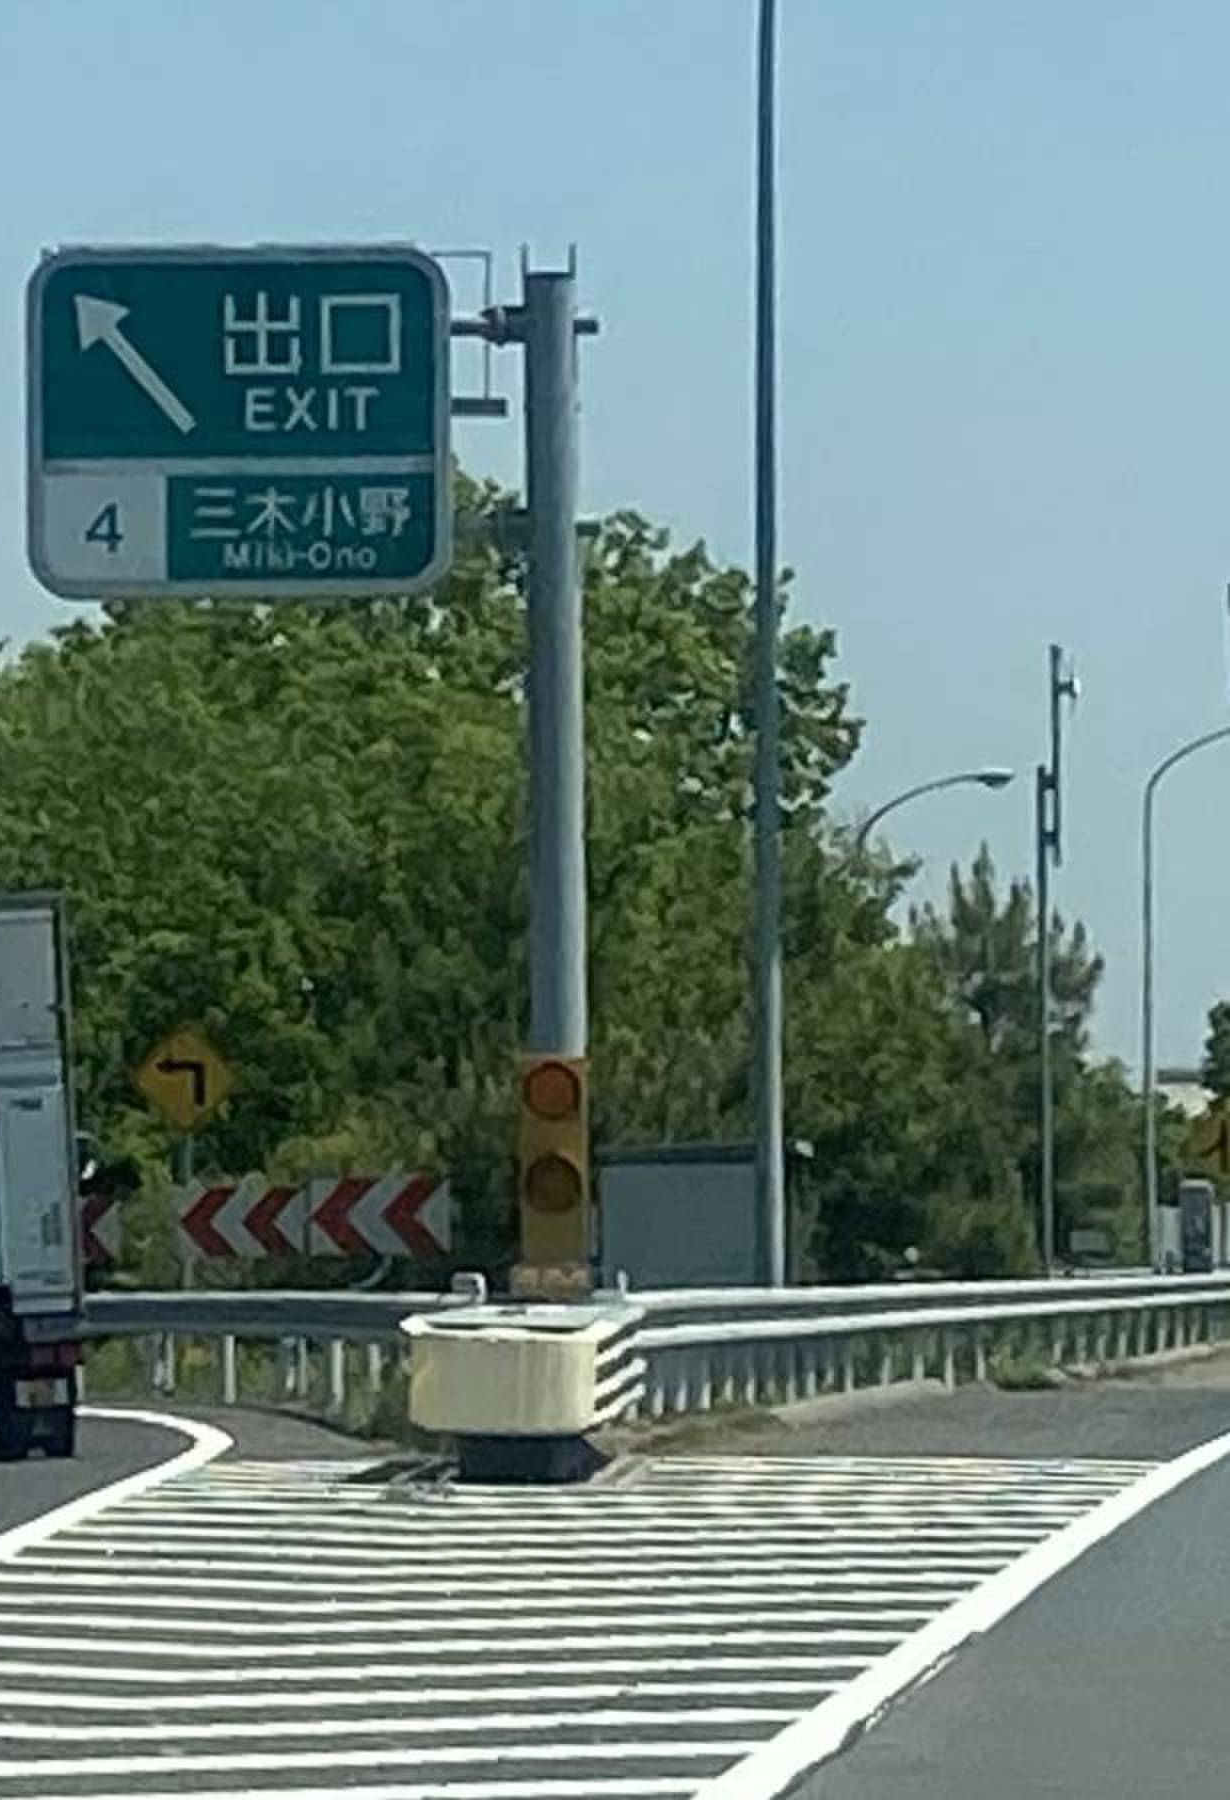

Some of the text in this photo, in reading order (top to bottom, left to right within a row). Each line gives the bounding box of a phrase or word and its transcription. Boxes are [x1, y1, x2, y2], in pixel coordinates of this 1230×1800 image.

[223, 293, 403, 376] 出口
[244, 387, 380, 432] EXIT
[84, 503, 124, 554] 4
[190, 486, 412, 540] 三木小野
